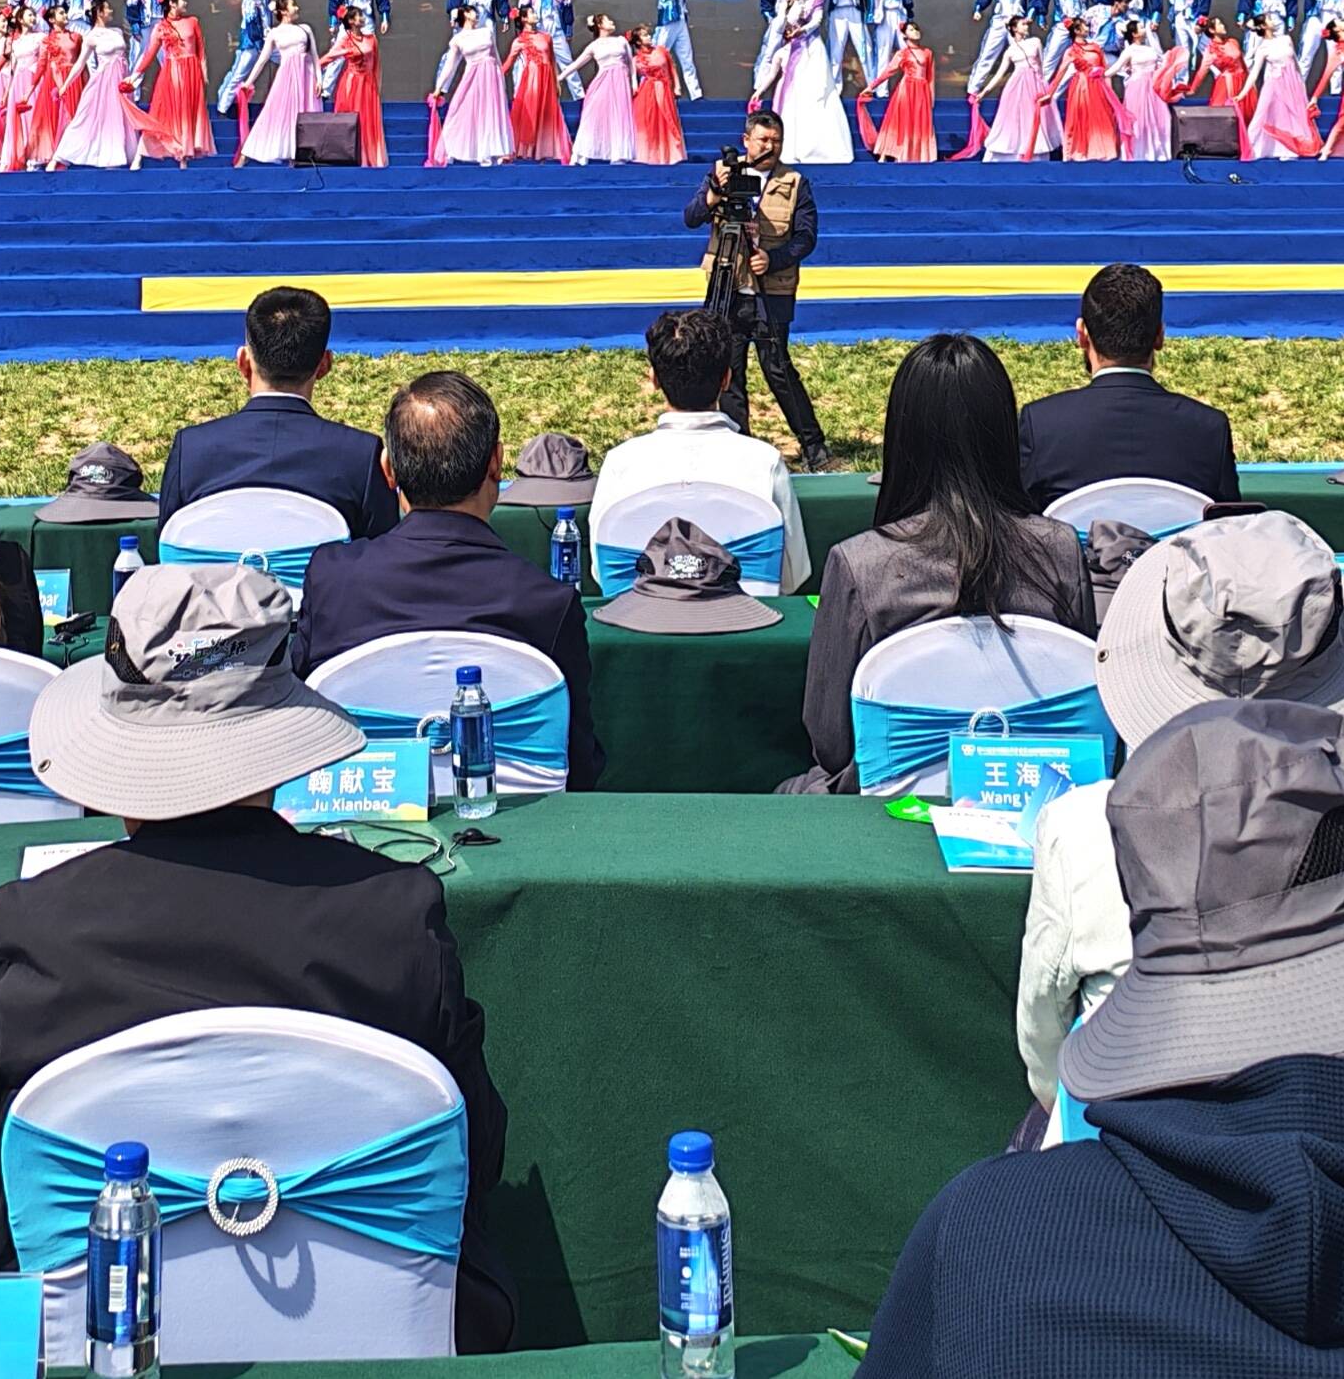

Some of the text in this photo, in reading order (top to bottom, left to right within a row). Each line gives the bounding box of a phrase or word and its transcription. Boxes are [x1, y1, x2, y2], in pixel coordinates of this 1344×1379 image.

[307, 766, 397, 795] 鞠献宝
[311, 796, 390, 813] Ju Xianbao
[980, 790, 1023, 808] Wang
